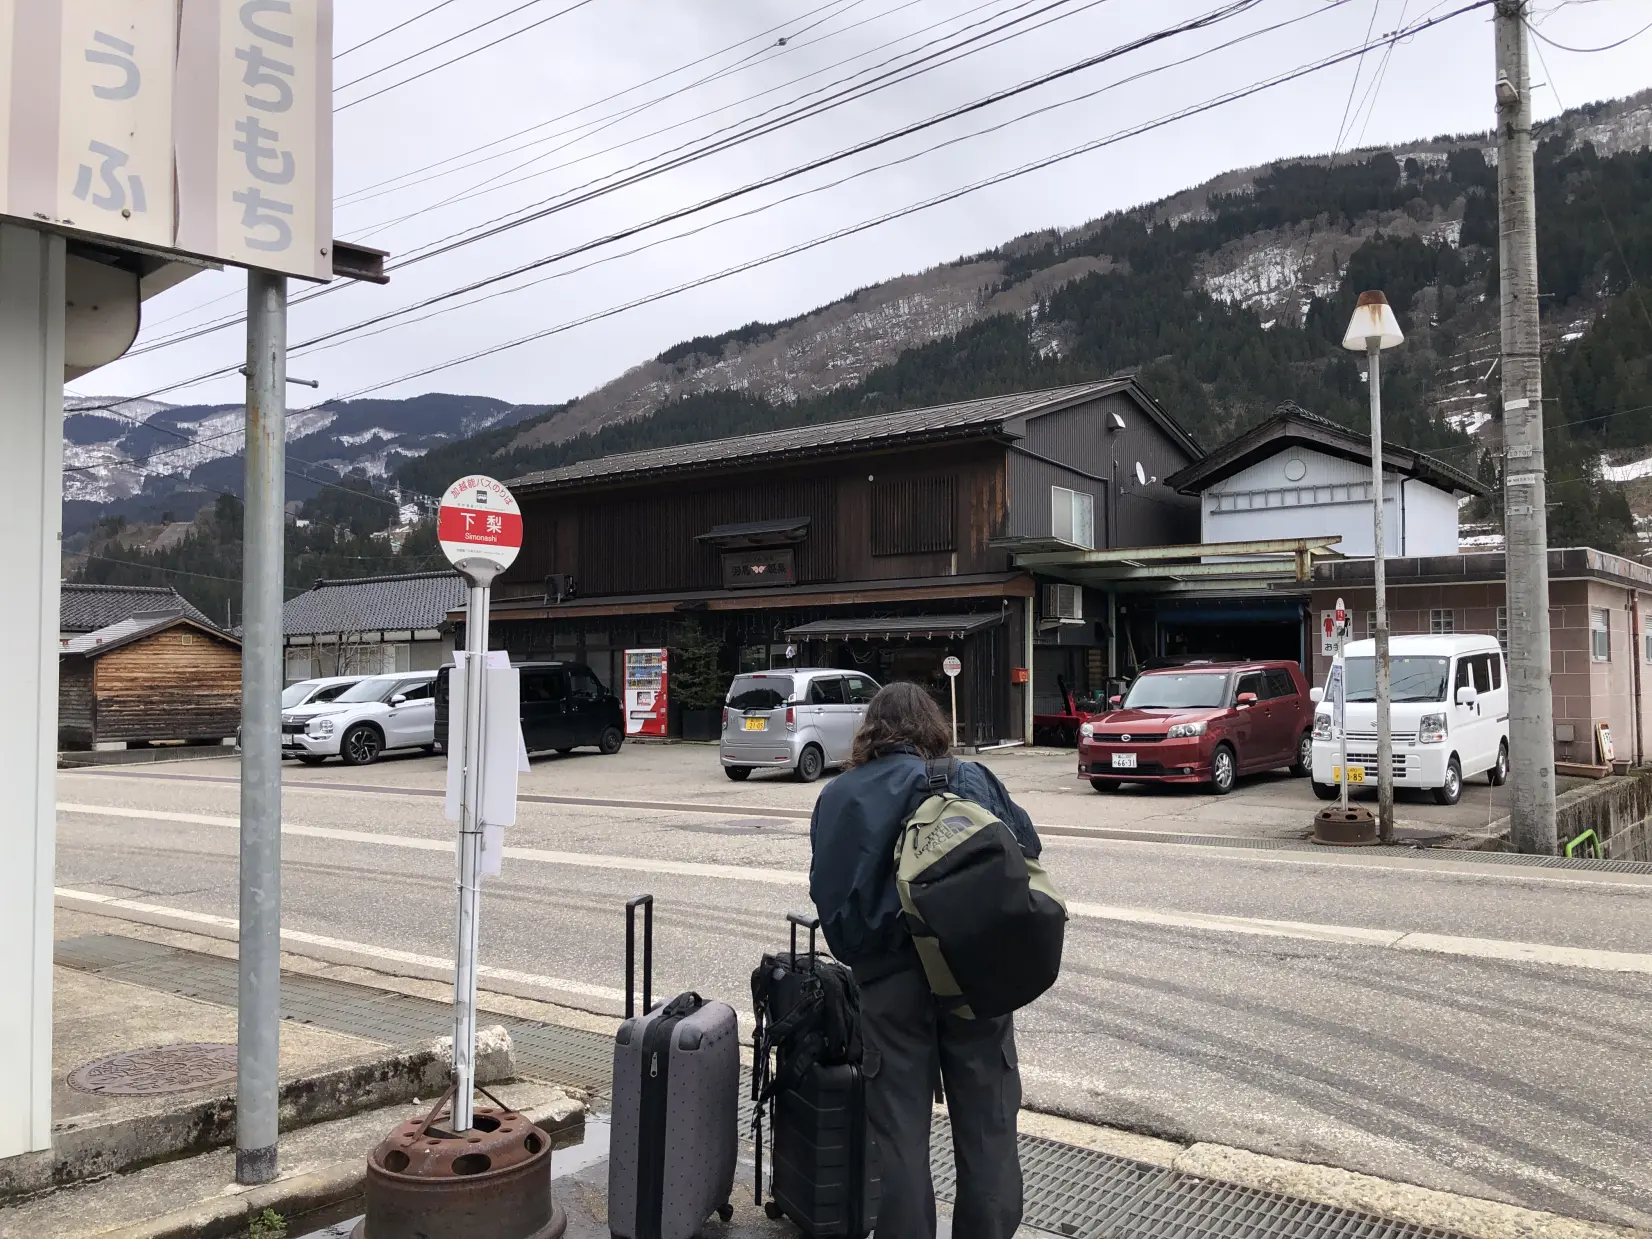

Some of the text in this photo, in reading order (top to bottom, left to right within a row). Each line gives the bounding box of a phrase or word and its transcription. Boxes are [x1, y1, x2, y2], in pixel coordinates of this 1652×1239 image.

[450, 477, 514, 506] 加越能バスのりば
[460, 512, 502, 533] 下梨
[464, 532, 498, 543] Simonashi
